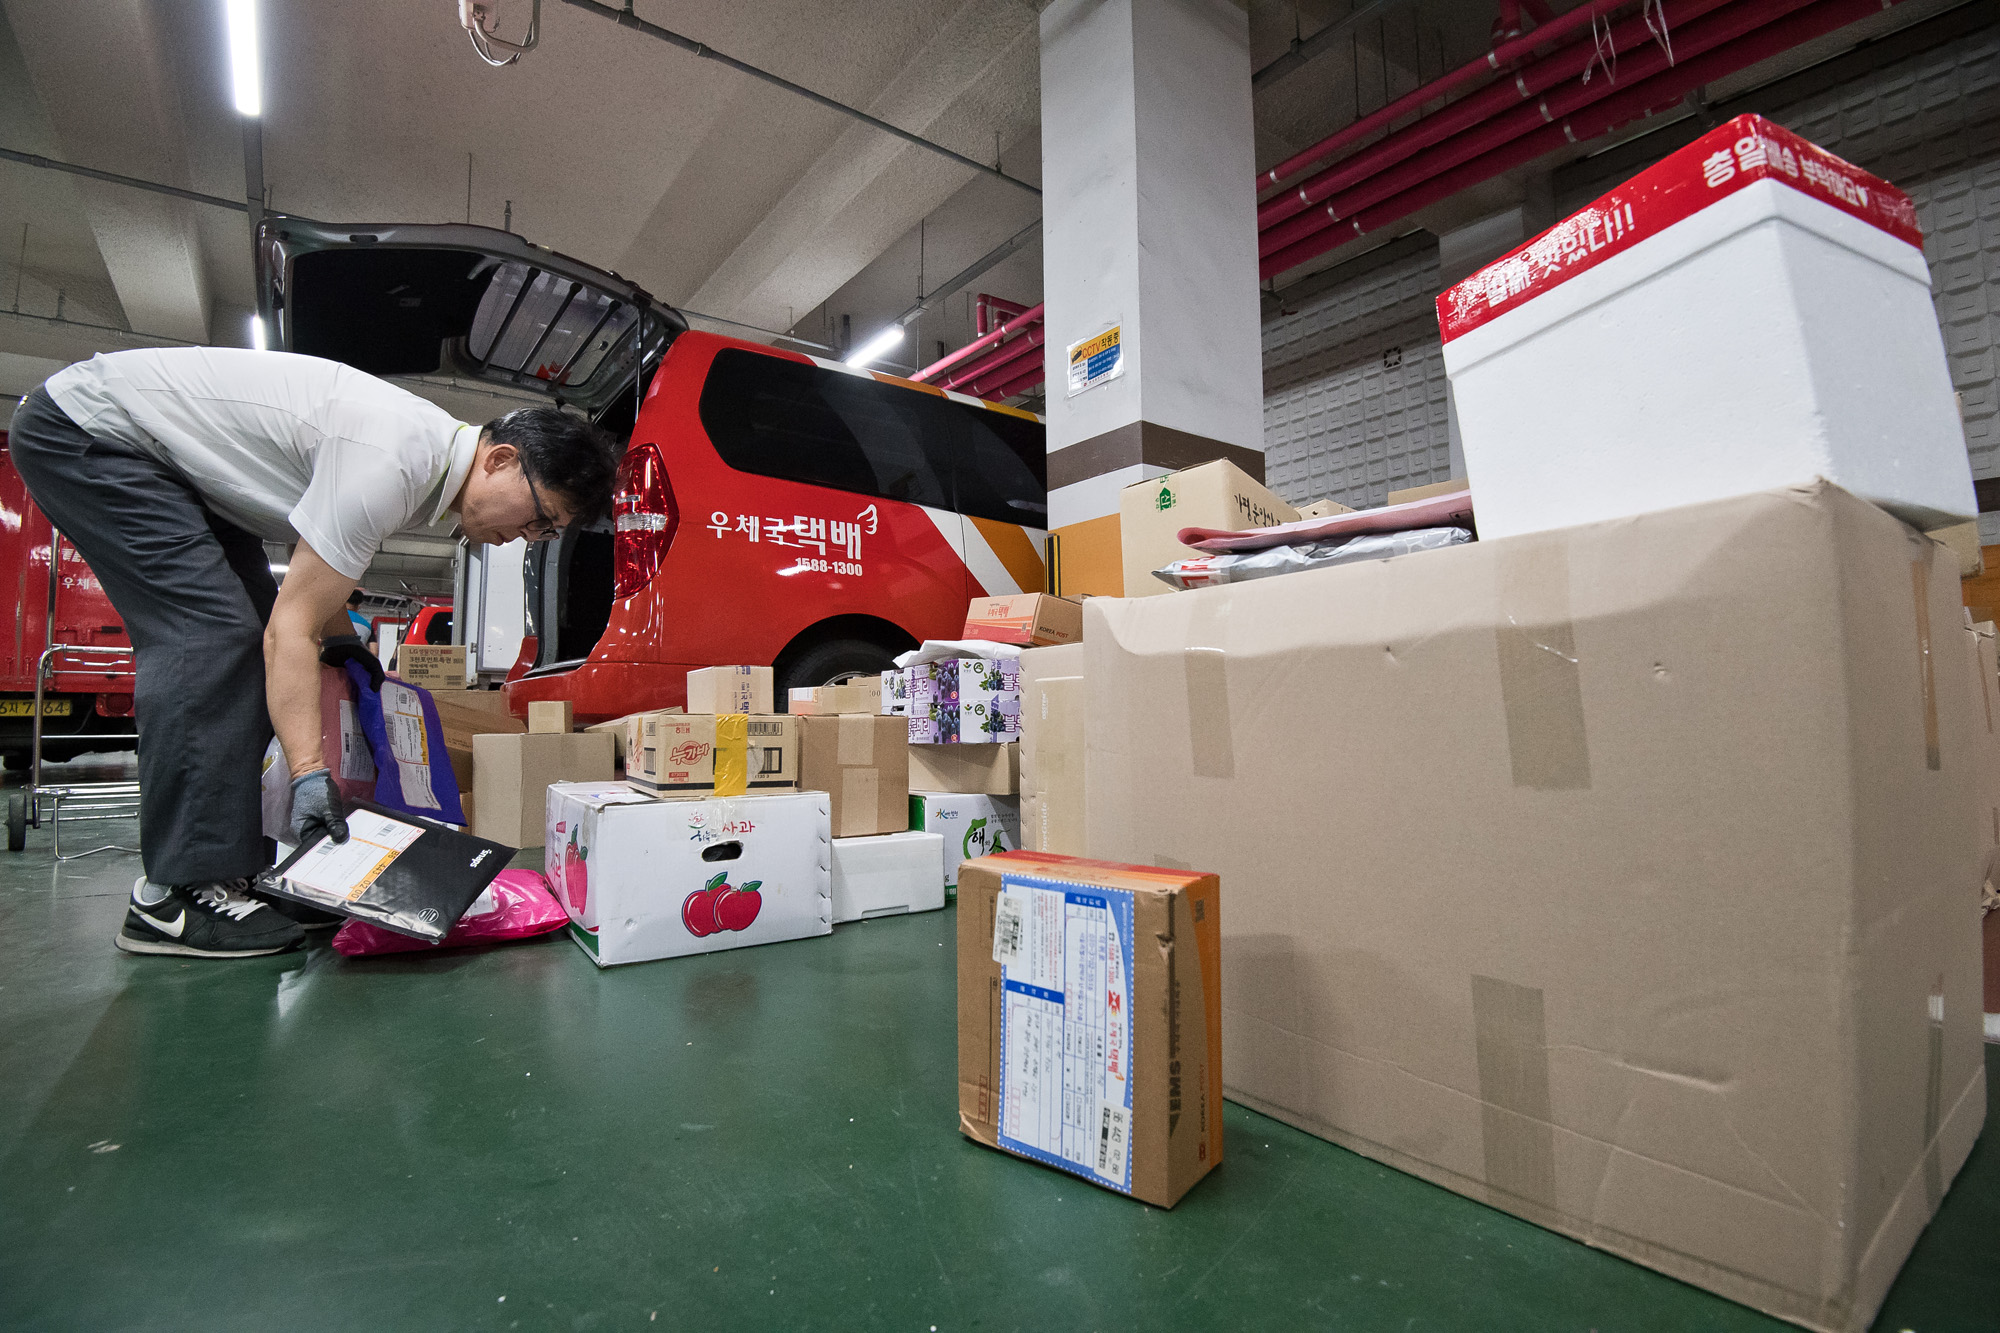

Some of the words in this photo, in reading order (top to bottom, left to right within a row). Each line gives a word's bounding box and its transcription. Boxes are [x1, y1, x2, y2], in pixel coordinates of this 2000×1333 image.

[1082, 341, 1101, 359] CCTV
[1101, 331, 1119, 348] 작동중
[795, 557, 863, 576] 1588-1300
[1038, 625, 1056, 636] KOREA
[1056, 631, 1069, 639] POST
[22, 701, 65, 714] 764
[670, 742, 710, 766] 누가바
[722, 820, 756, 834] 사과
[469, 849, 490, 868] snaps
[372, 862, 387, 876] 443
[1169, 1060, 1181, 1112] EMS
